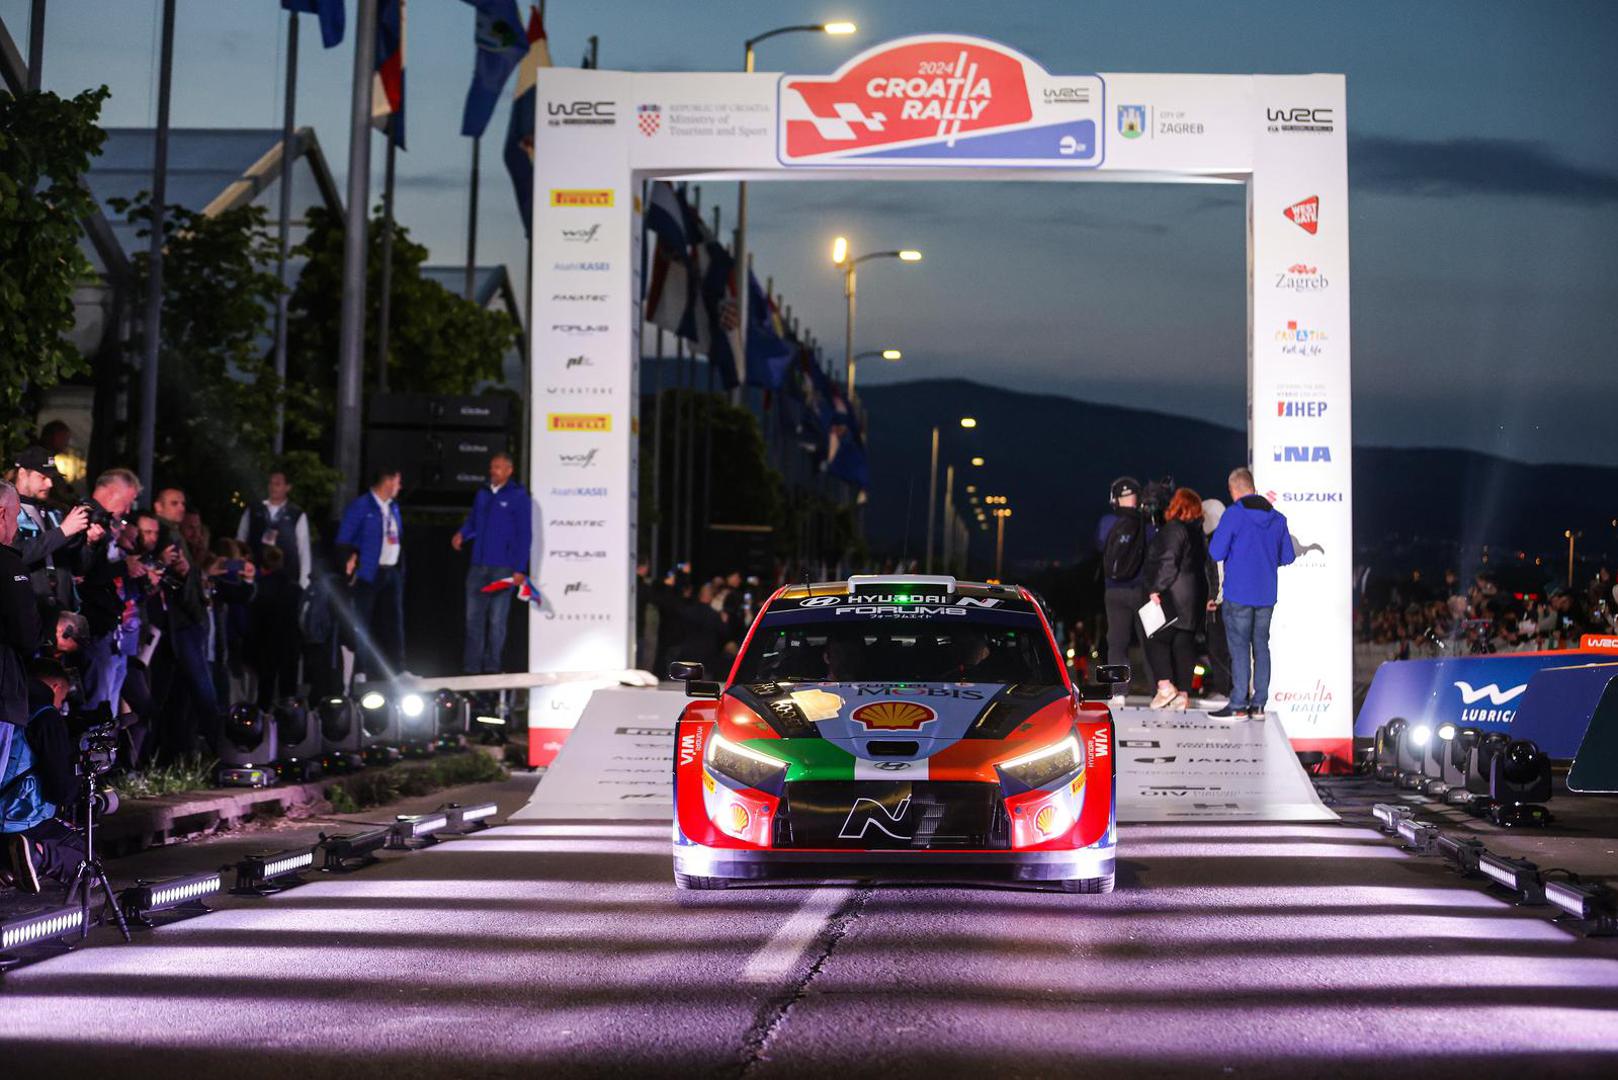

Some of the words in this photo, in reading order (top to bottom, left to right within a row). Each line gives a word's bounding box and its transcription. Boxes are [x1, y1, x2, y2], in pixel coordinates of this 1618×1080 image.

[918, 61, 954, 75] 2024
[866, 77, 992, 99] CROATIA
[1043, 87, 1090, 98] WRC
[548, 101, 616, 116] WRC
[901, 100, 990, 120] RALLY
[669, 114, 714, 126] Ministry
[718, 114, 730, 124] of
[1267, 107, 1333, 123] WRC
[669, 126, 714, 136] Tourism
[716, 126, 735, 136] and
[738, 126, 768, 138] Sport
[1160, 123, 1204, 134] ZAGREB
[1275, 273, 1329, 292] Zagreb
[1295, 401, 1328, 417] HEP
[1282, 492, 1343, 502] SUZUKI
[550, 519, 606, 527] FANATEC
[848, 594, 946, 605] HYUDAI
[835, 606, 967, 616] FORUM8
[1587, 638, 1618, 648] WRC
[857, 687, 985, 701] MOBIS
[1274, 692, 1333, 702] CROATIA
[1461, 709, 1517, 723] LUBRIC
